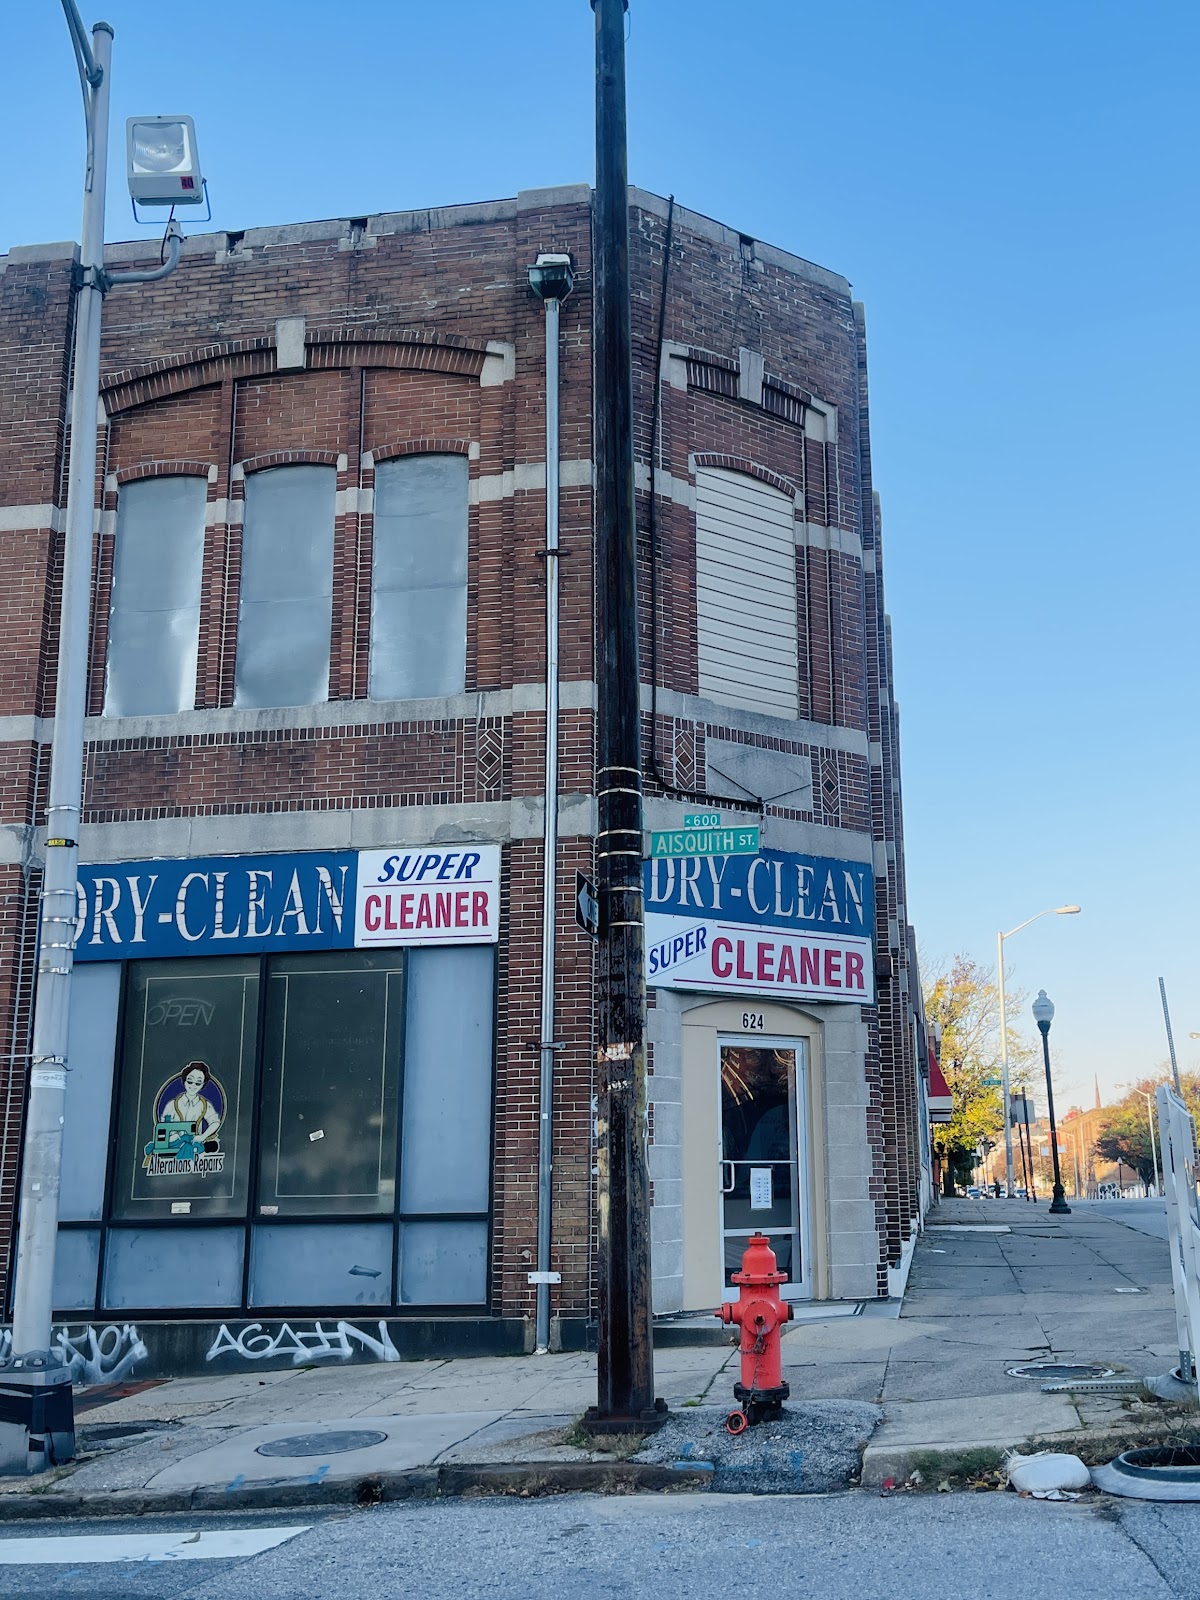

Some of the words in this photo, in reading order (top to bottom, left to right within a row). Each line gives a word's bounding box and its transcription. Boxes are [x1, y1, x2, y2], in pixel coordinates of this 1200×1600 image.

[693, 815, 718, 826] 600
[656, 831, 734, 854] AISQUITH
[739, 834, 755, 846] ST.
[377, 852, 481, 883] SUPER
[648, 856, 864, 927] DRY-CLEAN
[364, 891, 489, 932] CLEANER
[649, 926, 707, 975] SUPER
[711, 937, 865, 990] CLEANER
[146, 1004, 216, 1026] OPEN
[742, 1013, 764, 1030] 624
[148, 1154, 192, 1175] Alterations
[193, 1153, 223, 1177] Repairs
[206, 1321, 400, 1364] AGAIN
